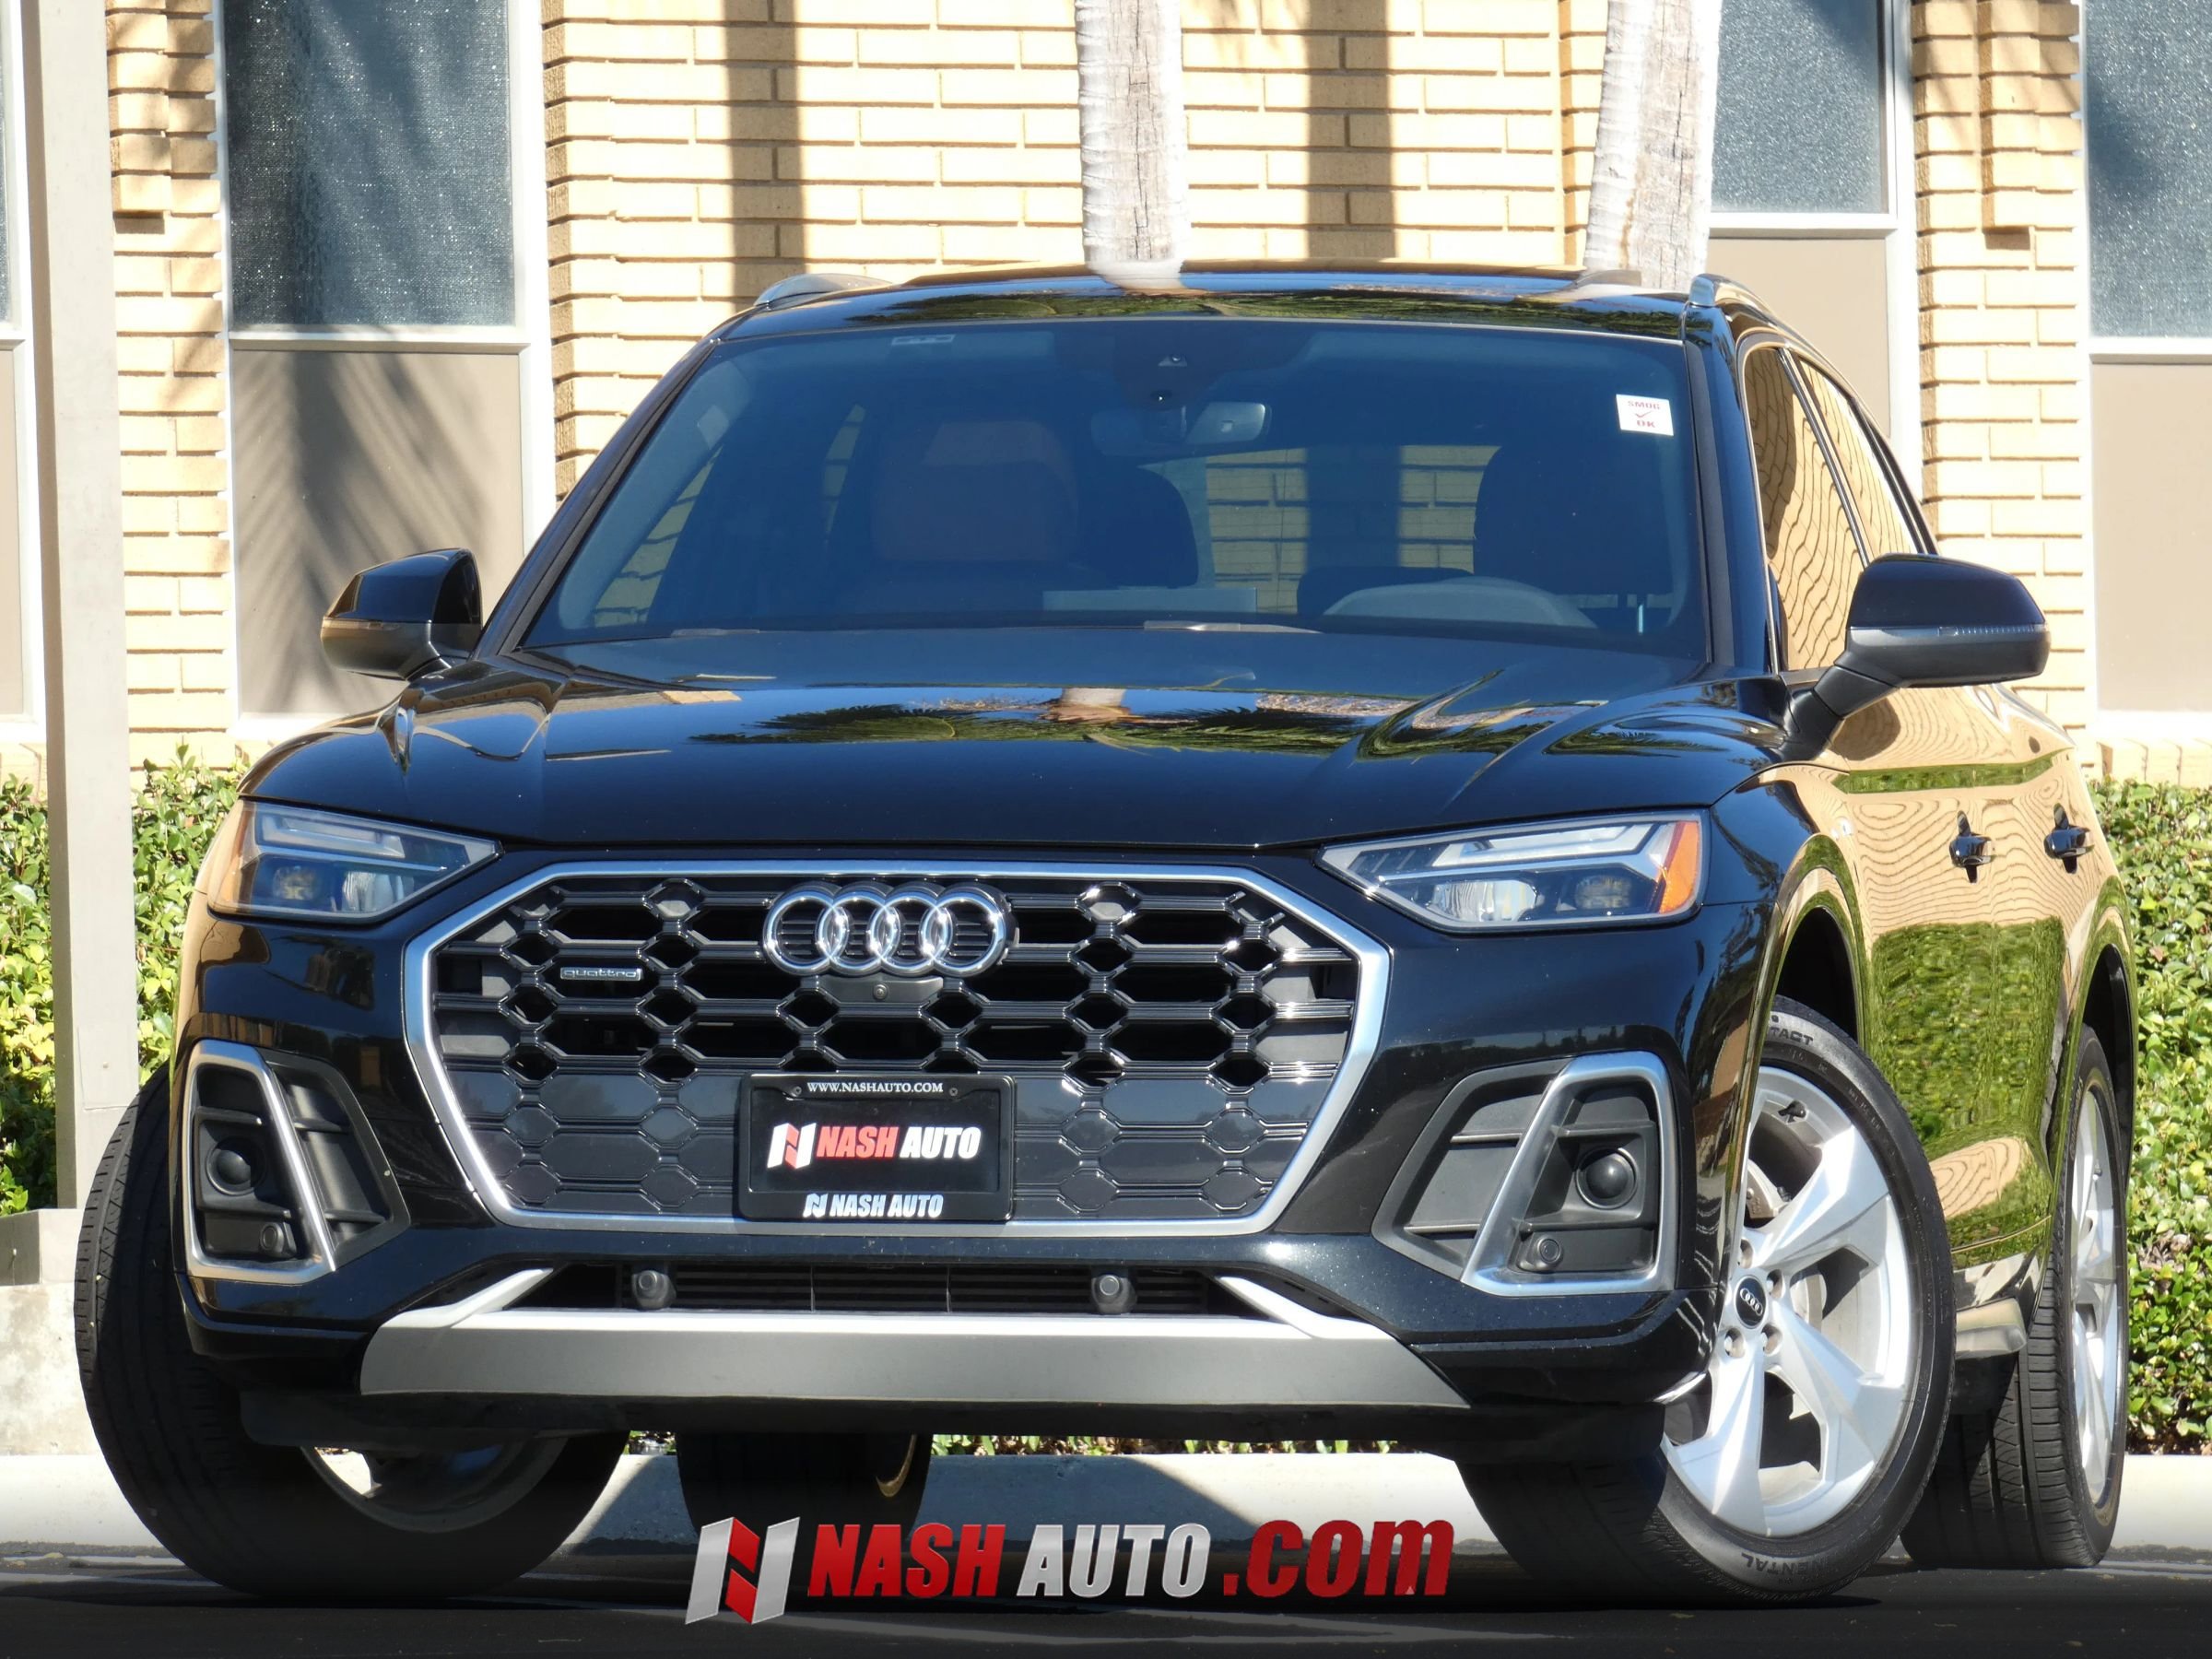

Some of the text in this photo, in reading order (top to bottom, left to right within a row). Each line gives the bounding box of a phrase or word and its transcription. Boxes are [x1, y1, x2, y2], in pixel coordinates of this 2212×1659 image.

[1628, 401, 1660, 410] SMOG
[564, 969, 637, 978] quattro
[807, 1082, 944, 1093] WWW.NASHAUTO.COM
[816, 1126, 900, 1159] NASH
[900, 1126, 982, 1159] AUTO
[830, 1194, 887, 1218] NASH
[887, 1194, 945, 1218] AUTO
